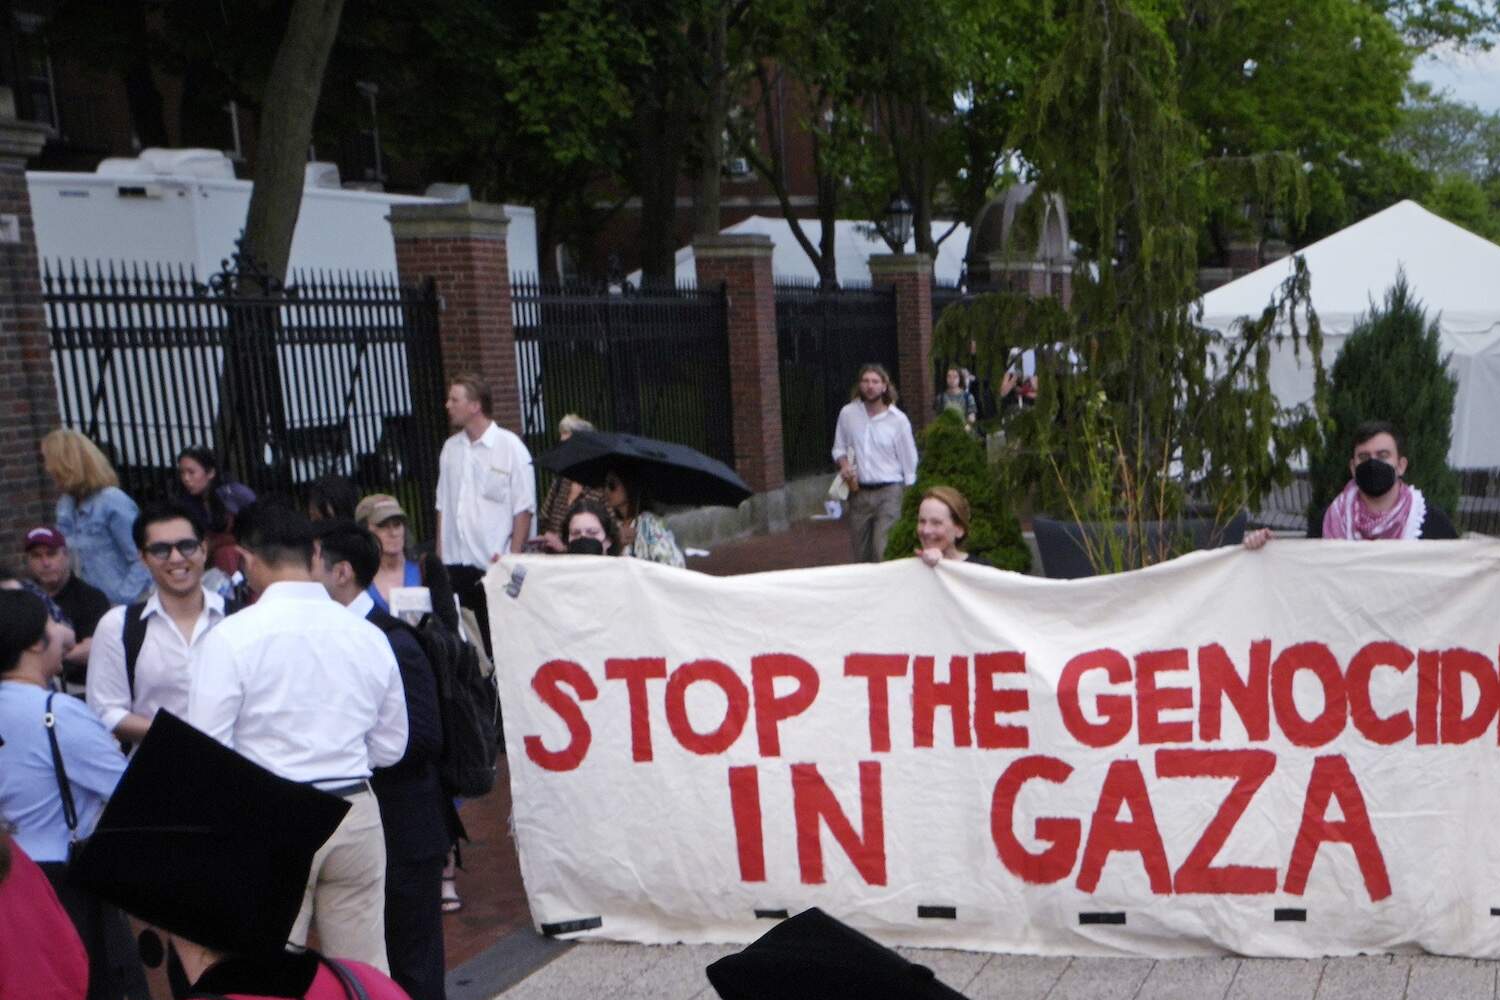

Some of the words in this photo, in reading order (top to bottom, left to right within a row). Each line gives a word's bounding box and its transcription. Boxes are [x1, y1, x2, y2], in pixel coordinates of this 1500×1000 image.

[523, 652, 821, 773] STOP
[843, 651, 1031, 752] THE
[728, 760, 888, 886] IN
[990, 747, 1393, 902] GAZA
